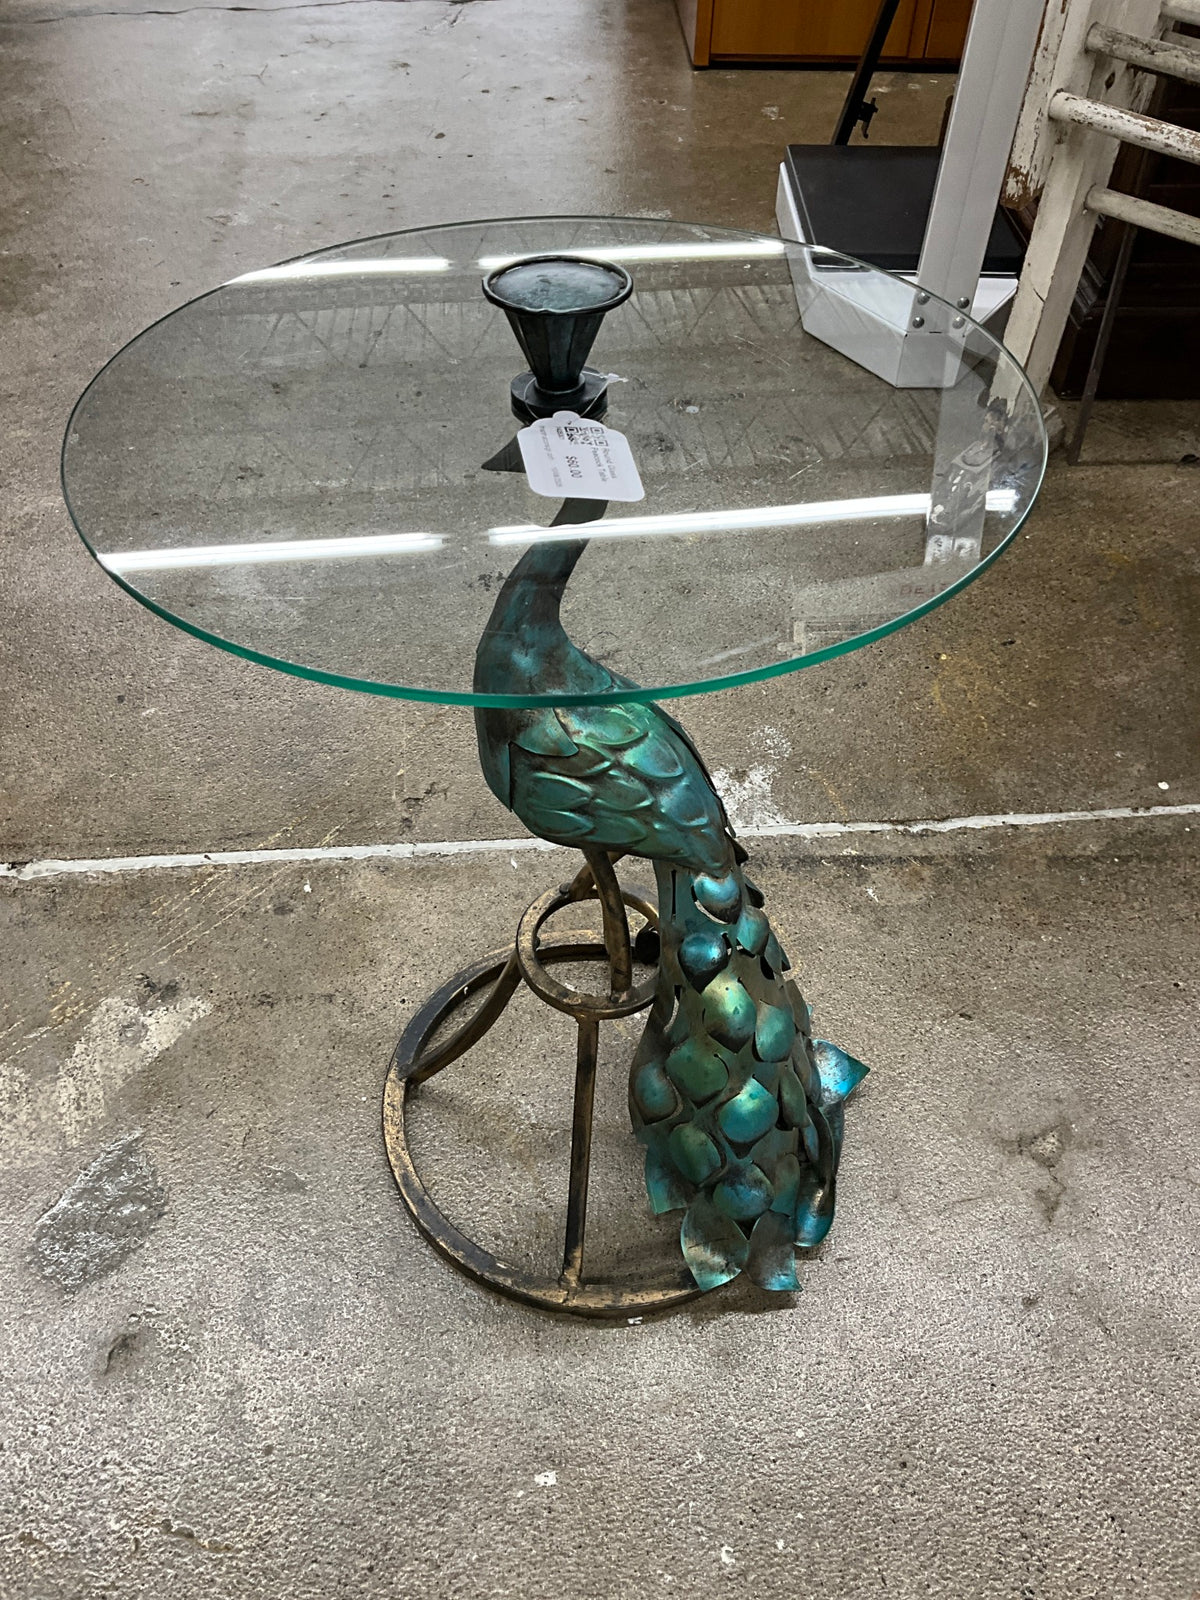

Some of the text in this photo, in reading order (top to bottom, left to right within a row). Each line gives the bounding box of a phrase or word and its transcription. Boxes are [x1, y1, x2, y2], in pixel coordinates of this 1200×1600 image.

[566, 456, 583, 478] $60.00
[592, 447, 608, 482] Peacock Table
[602, 448, 613, 465] Round
